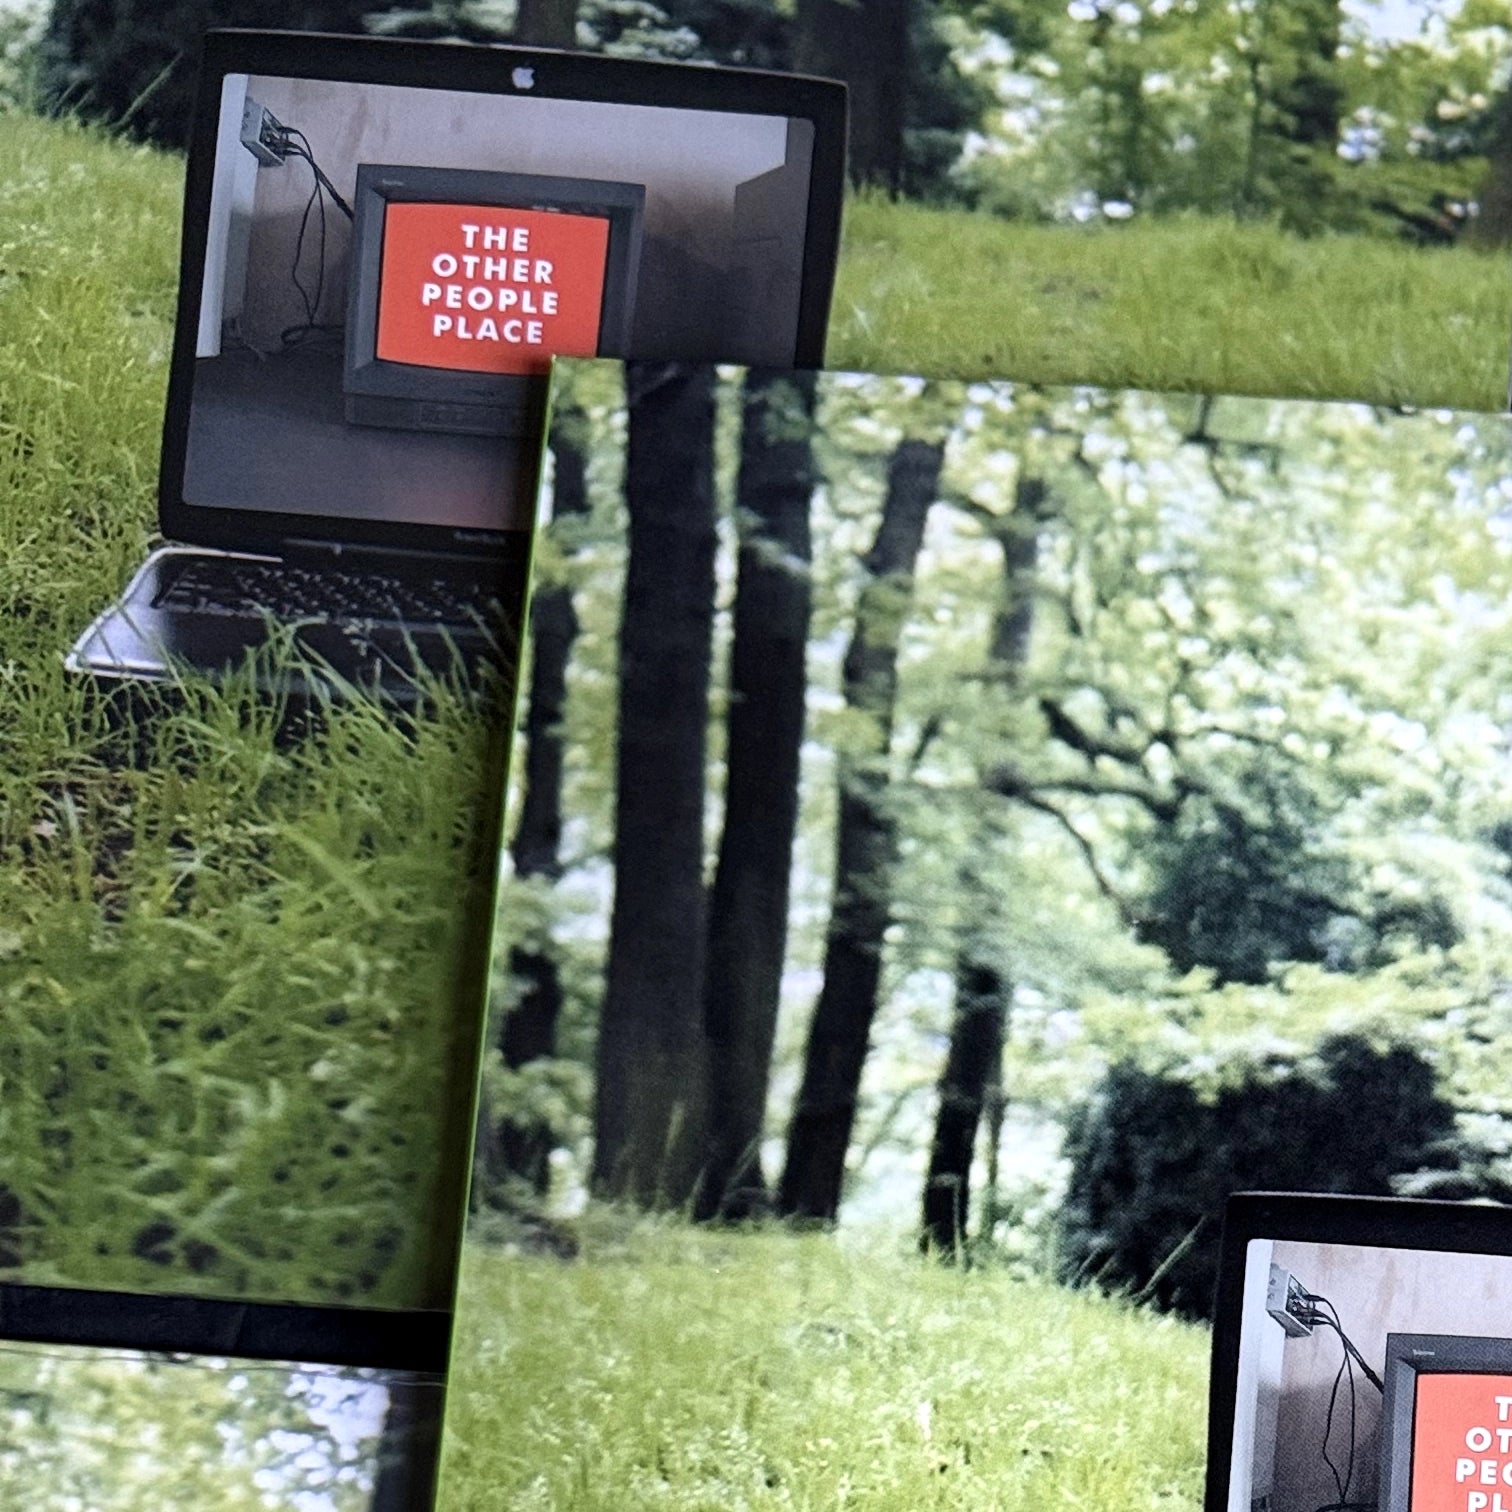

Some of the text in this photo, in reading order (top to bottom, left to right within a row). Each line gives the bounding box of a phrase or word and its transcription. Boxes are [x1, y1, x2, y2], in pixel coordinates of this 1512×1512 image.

[461, 223, 530, 252] THE
[431, 252, 553, 284] OTHER
[421, 282, 559, 315] PEOPLE
[433, 315, 543, 344] PLACE
